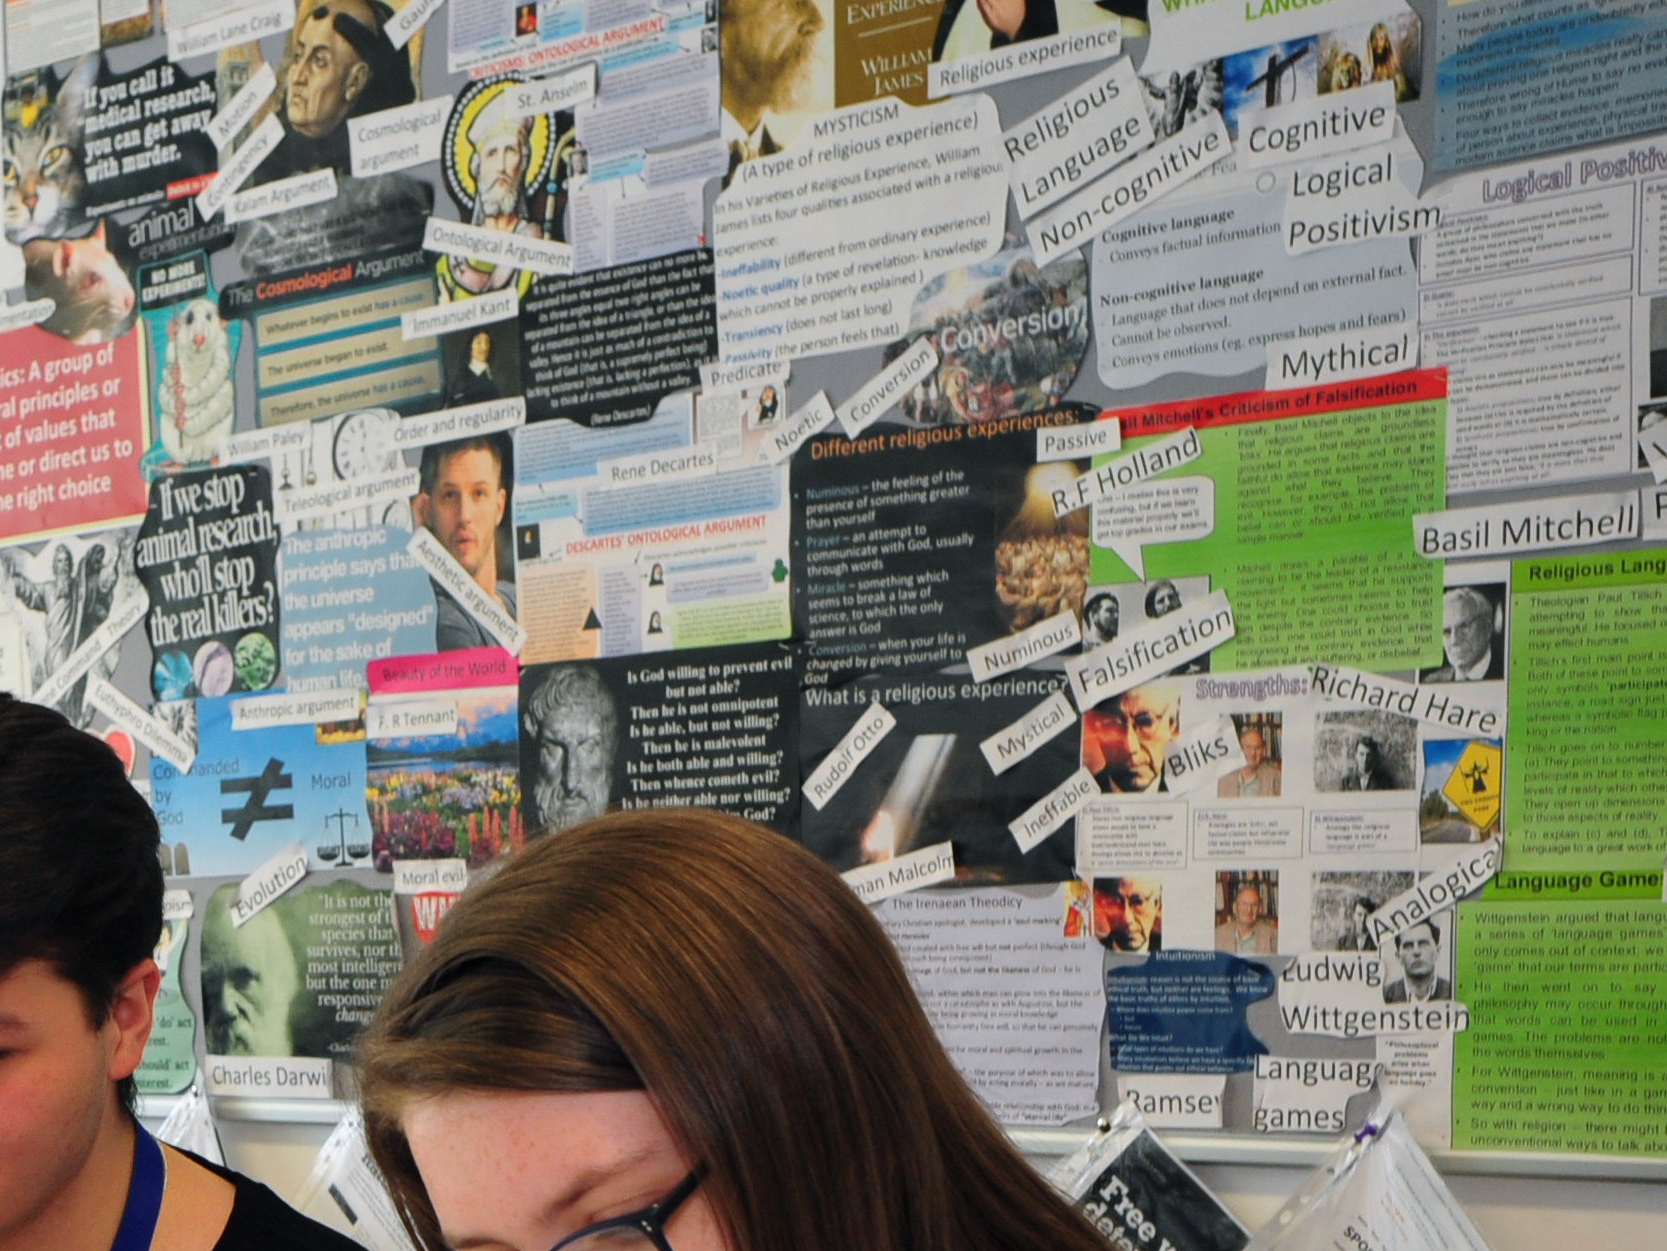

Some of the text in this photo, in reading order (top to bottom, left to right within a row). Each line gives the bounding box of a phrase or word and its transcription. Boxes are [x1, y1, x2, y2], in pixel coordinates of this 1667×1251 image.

[940, 28, 1118, 87] Religious experience
[218, 91, 258, 136] Motion
[518, 77, 588, 109] St. Anselm
[358, 108, 441, 143] Cosmological
[813, 104, 900, 138] MYSTICISM
[1004, 77, 1121, 163] Religious
[1249, 105, 1385, 153] Cognitive
[360, 143, 419, 171] argument
[742, 111, 978, 184] (A type of religious experience)
[1021, 114, 1142, 204] Language
[206, 134, 269, 206] Contingency
[1293, 152, 1392, 198] Logical
[1483, 162, 1571, 204] Logical
[1040, 129, 1220, 254] Non-cognitive
[1102, 207, 1235, 244] Cognitive language
[1290, 203, 1441, 248] Positivism
[433, 226, 571, 268] Ontological Argument
[940, 303, 1080, 353] Conversion
[28, 359, 41, 379] A
[44, 354, 94, 383] group
[96, 341, 115, 363] of
[710, 361, 781, 387] Predicate
[1281, 334, 1409, 381] Mythical
[20, 381, 99, 415] principles
[103, 377, 121, 396] or
[849, 349, 931, 424] Conversion
[1315, 381, 1418, 404] Falsification
[5, 427, 22, 448] of
[25, 415, 77, 443] values
[81, 408, 116, 433] that
[393, 403, 523, 444] Order and regularity
[774, 409, 824, 453] Noetic
[810, 409, 1080, 461] Different religious experiences:
[1044, 428, 1108, 453] Passive
[17, 459, 37, 478] or
[39, 444, 87, 472] direct
[91, 444, 110, 461] us
[114, 438, 133, 458] to
[611, 452, 714, 482] Rene Decartes
[1051, 430, 1200, 516] R.F Holland
[17, 483, 54, 511] right
[58, 473, 111, 499] choice
[160, 472, 245, 521] If we stop
[137, 501, 280, 568] animal research,
[1422, 505, 1634, 554] Basil Mitchell
[215, 554, 254, 589] stop
[1529, 560, 1614, 581] Religious
[150, 580, 275, 648] the real killers?
[627, 655, 793, 684] Is God willing to prevent evil
[983, 624, 1073, 673] Numinous
[1078, 608, 1233, 694] Falsification
[382, 661, 506, 685] Beauty of the World
[805, 674, 1068, 707] What is a religious experience?
[1195, 674, 1308, 701] Strengths:
[240, 697, 355, 722] Anthropic argument
[1312, 665, 1497, 734] Richard Hare
[996, 703, 1065, 759] Mystical
[814, 716, 884, 800] Rudolf Otto
[1167, 735, 1230, 779] Bliks
[1023, 778, 1091, 838] Ineffable
[236, 856, 306, 920] Evolution
[1494, 871, 1592, 891] Language
[892, 895, 1023, 912] The Irenaean Theodicy
[1281, 1000, 1470, 1037] Wittgenstein
[212, 1065, 270, 1087] Charles
[1254, 1057, 1384, 1087] Language
[1254, 1106, 1345, 1133] games
[1100, 1175, 1156, 1242] Free
